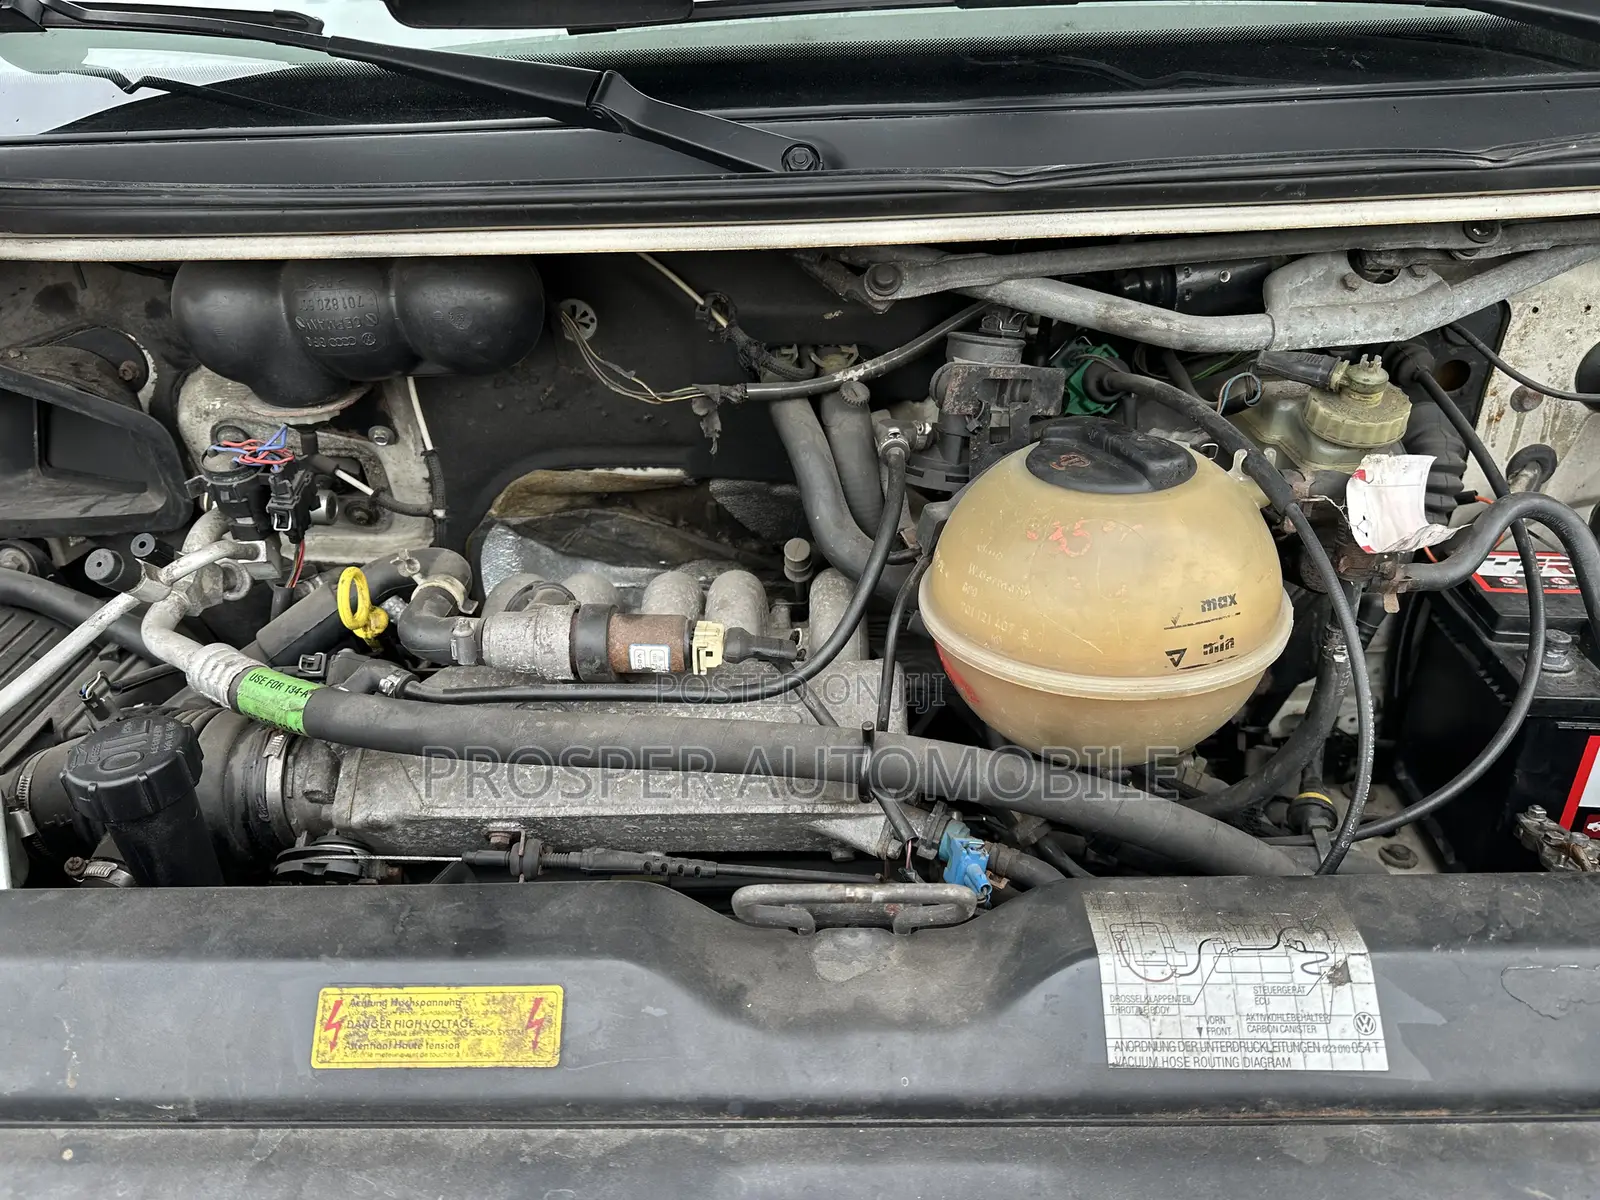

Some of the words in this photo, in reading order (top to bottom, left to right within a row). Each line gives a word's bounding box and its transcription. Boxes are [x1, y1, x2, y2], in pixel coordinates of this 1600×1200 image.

[1200, 593, 1237, 612] max
[1203, 634, 1234, 656] min
[249, 673, 269, 685] USE
[265, 678, 285, 690] FOR
[1254, 996, 1270, 1006] ECU
[346, 1019, 391, 1029] DANGER
[1206, 1016, 1226, 1025] VORN
[1206, 1026, 1231, 1036] FRONT
[1247, 1025, 1278, 1034] CARBON
[1279, 1025, 1317, 1034] CANISTER
[1114, 1040, 1176, 1053] ANORDNUNG
[1178, 1040, 1197, 1053] DER
[1200, 1040, 1321, 1053] UNTERDRUCKLEITUNGEN
[1114, 1056, 1158, 1068] VACUUM
[1162, 1056, 1190, 1068] HOSE
[1193, 1056, 1240, 1068] ROUTING
[1243, 1056, 1292, 1069] DIAGRAM
